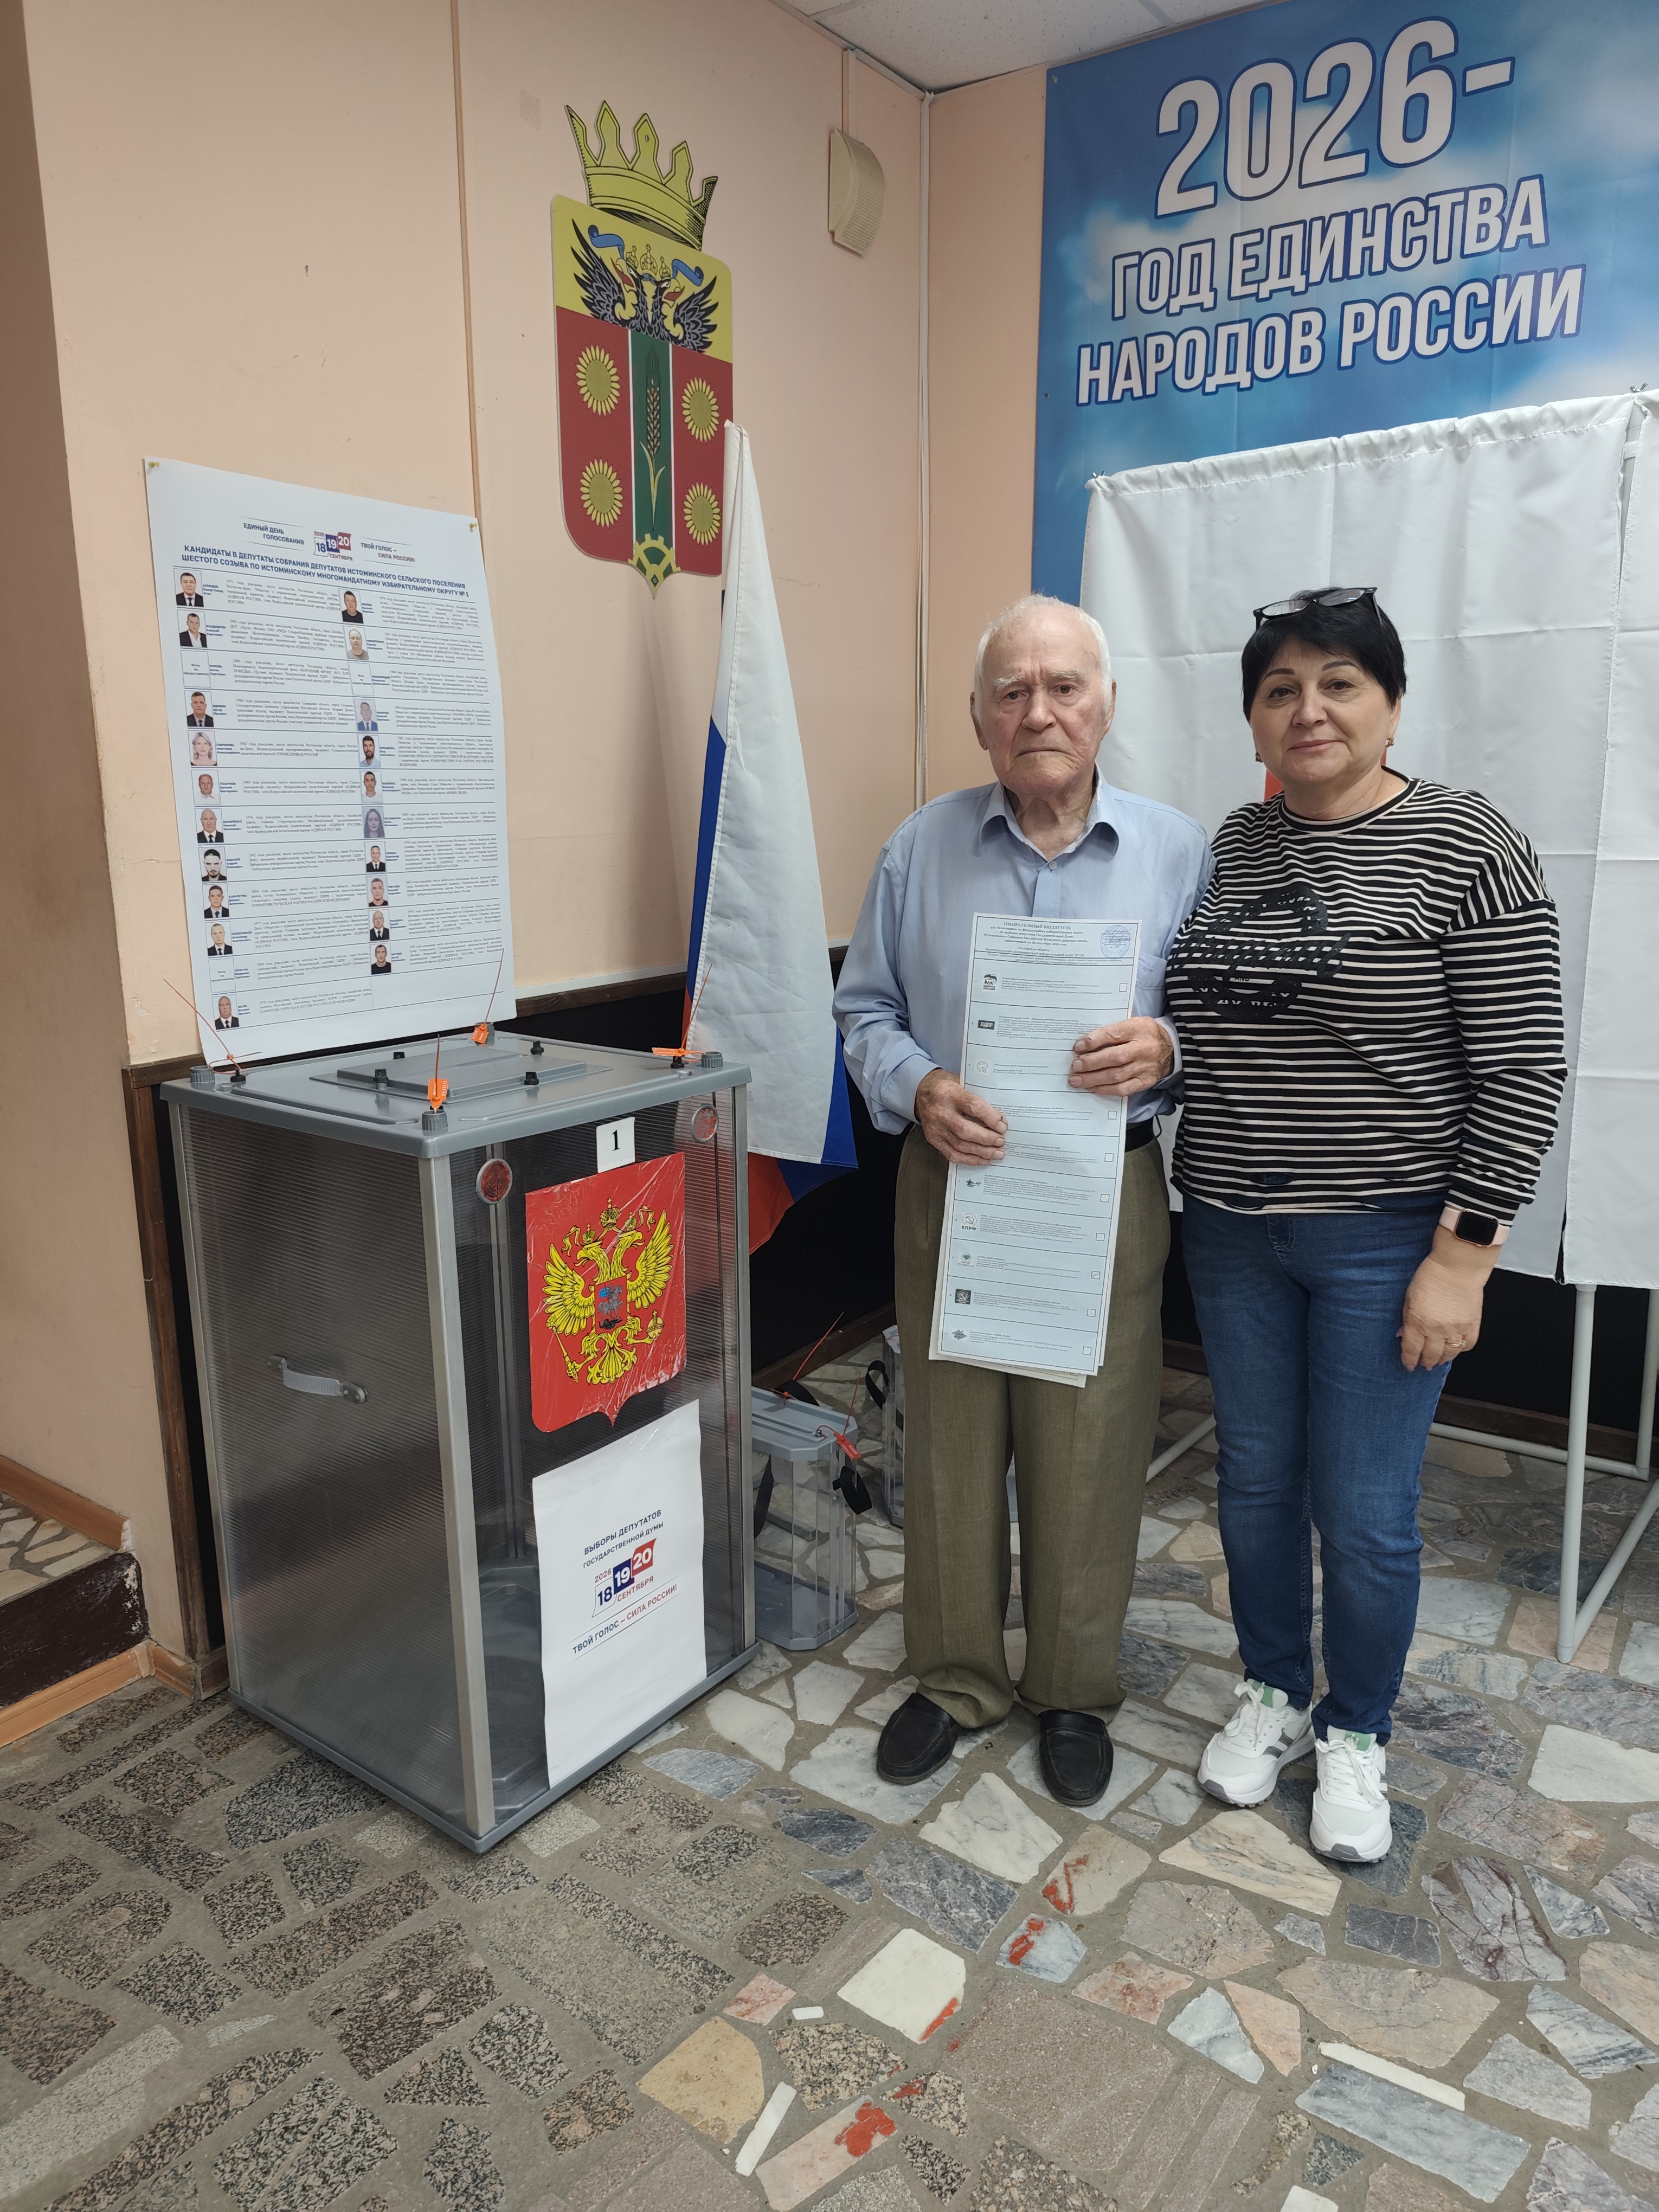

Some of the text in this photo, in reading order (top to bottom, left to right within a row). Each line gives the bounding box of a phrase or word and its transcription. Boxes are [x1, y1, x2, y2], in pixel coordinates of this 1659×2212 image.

[1156, 17, 1515, 217] 2026-
[1112, 174, 1548, 321] ГОД ЕДИНСТВА
[1077, 264, 1586, 407] НАРОДОВ РОССИИ
[243, 522, 268, 532] ЕДИНЫЙ
[263, 534, 304, 545] ГОЛОСОВАНИЯ
[316, 536, 350, 552] 18 19 20
[182, 555, 218, 563] ШЕСТОГО
[220, 559, 248, 568] СОЗЫВА
[261, 565, 315, 576] ИСТОМИНСКОМУ
[317, 573, 380, 585] МНОГОМАНДАТНОМУ
[382, 582, 435, 592] ИЗБИРАТЕЛЬНОМУ
[184, 545, 231, 556] КАНДИДАТЫ
[239, 552, 274, 562] ДЕПУТАТЫ
[275, 558, 309, 568] СОБРАНИЯ
[311, 563, 346, 573] ДЕПУТАТОВ
[347, 569, 396, 579] ИСТОМИНСКОГО
[397, 575, 431, 584] СЕЛЬСКОГО
[432, 580, 465, 588] ПОСЕЛЕНИЯ
[612, 1129, 620, 1151] 1
[583, 1521, 663, 1569] ГОСУДАРСТВЕННОЙ ДУМЫ
[584, 1509, 661, 1555] ВЫБОРЫ ДЕПУТАТОВ
[595, 1568, 612, 1583] 2026
[597, 1547, 652, 1606] 18 19 20
[617, 1575, 654, 1602] СЕНТЯБРЯ
[573, 1635, 593, 1654] ТВОЙ
[595, 1620, 619, 1641] ГОЛОС
[627, 1604, 646, 1620] СИЛА
[648, 1584, 677, 1607] РОССИИ!
